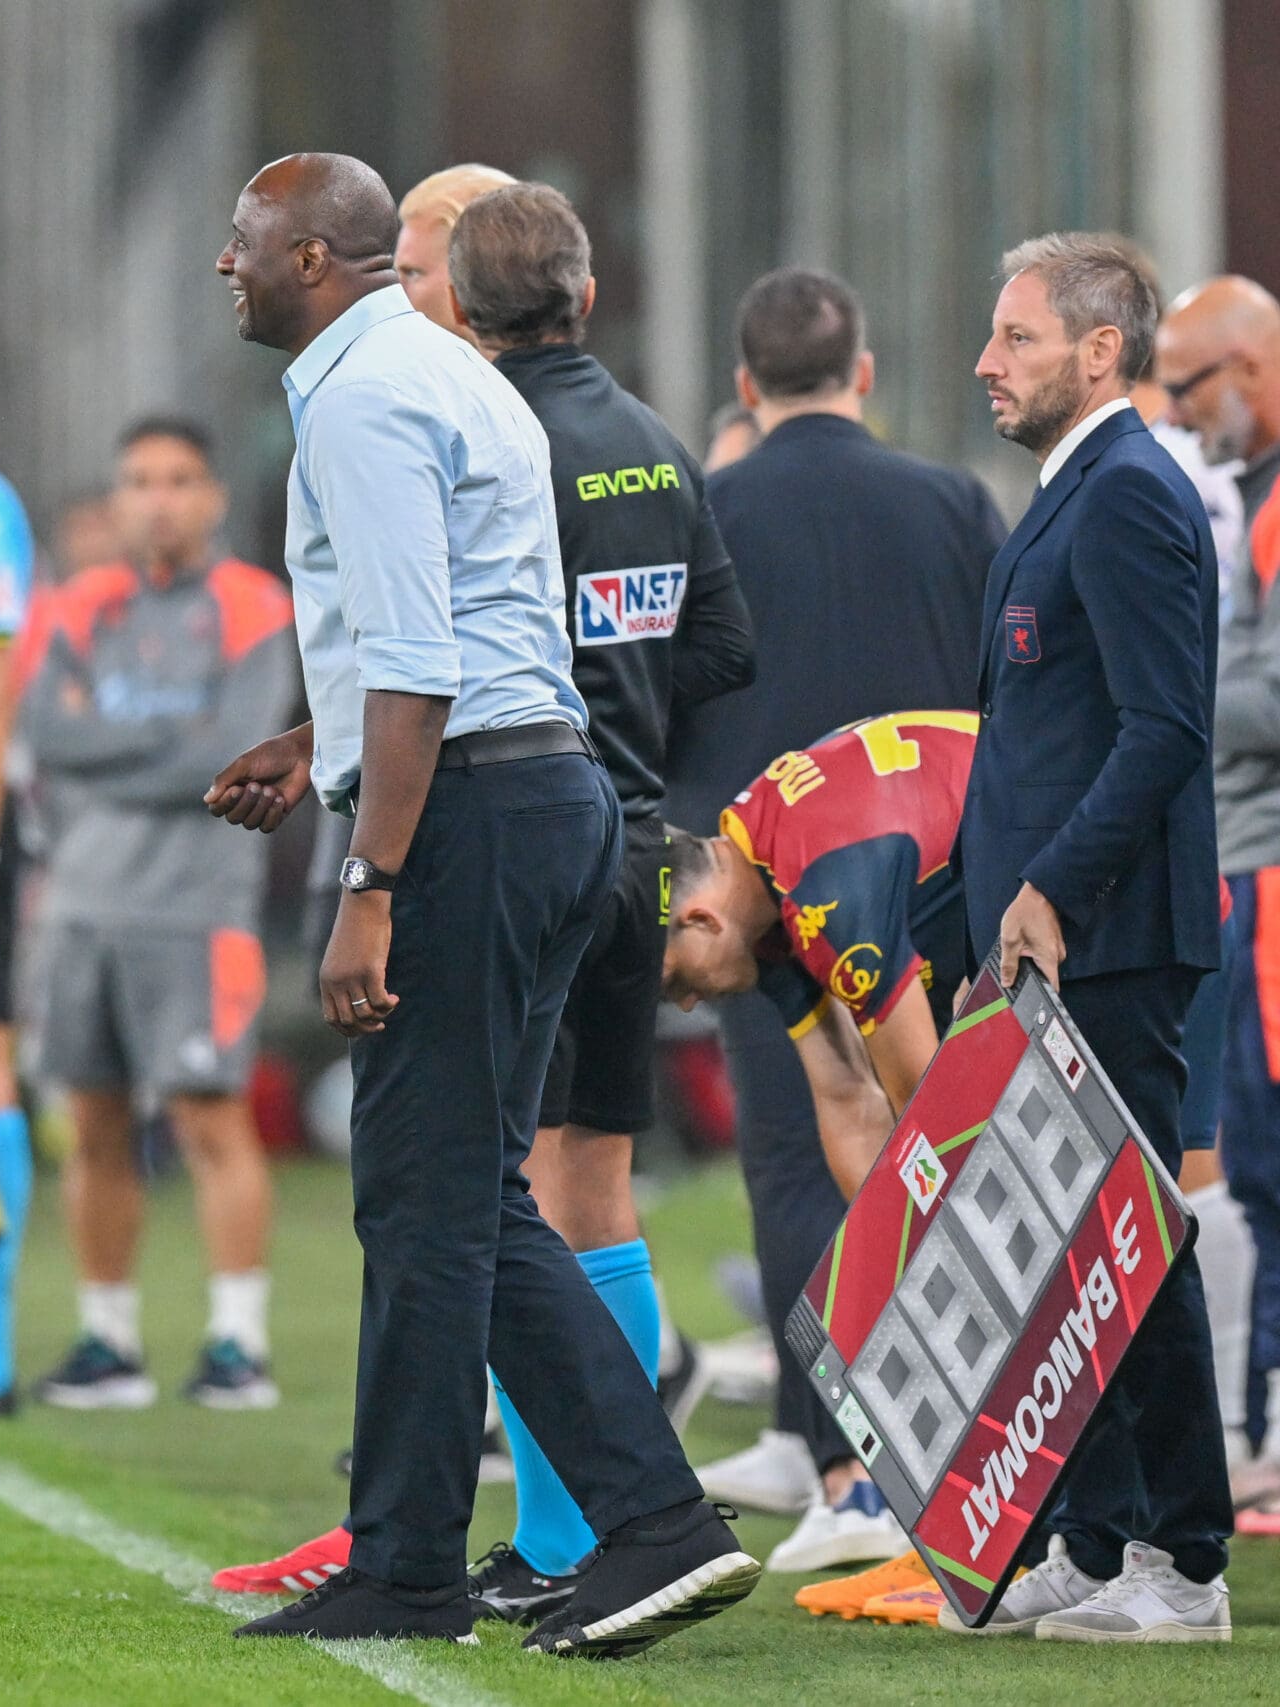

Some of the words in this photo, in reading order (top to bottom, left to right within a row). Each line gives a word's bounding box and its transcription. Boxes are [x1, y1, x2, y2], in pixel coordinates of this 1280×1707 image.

[576, 463, 680, 502] GIVOVA
[625, 570, 684, 613] NET
[1112, 1197, 1141, 1275] 3
[961, 1255, 1118, 1562] BANCOMAT
